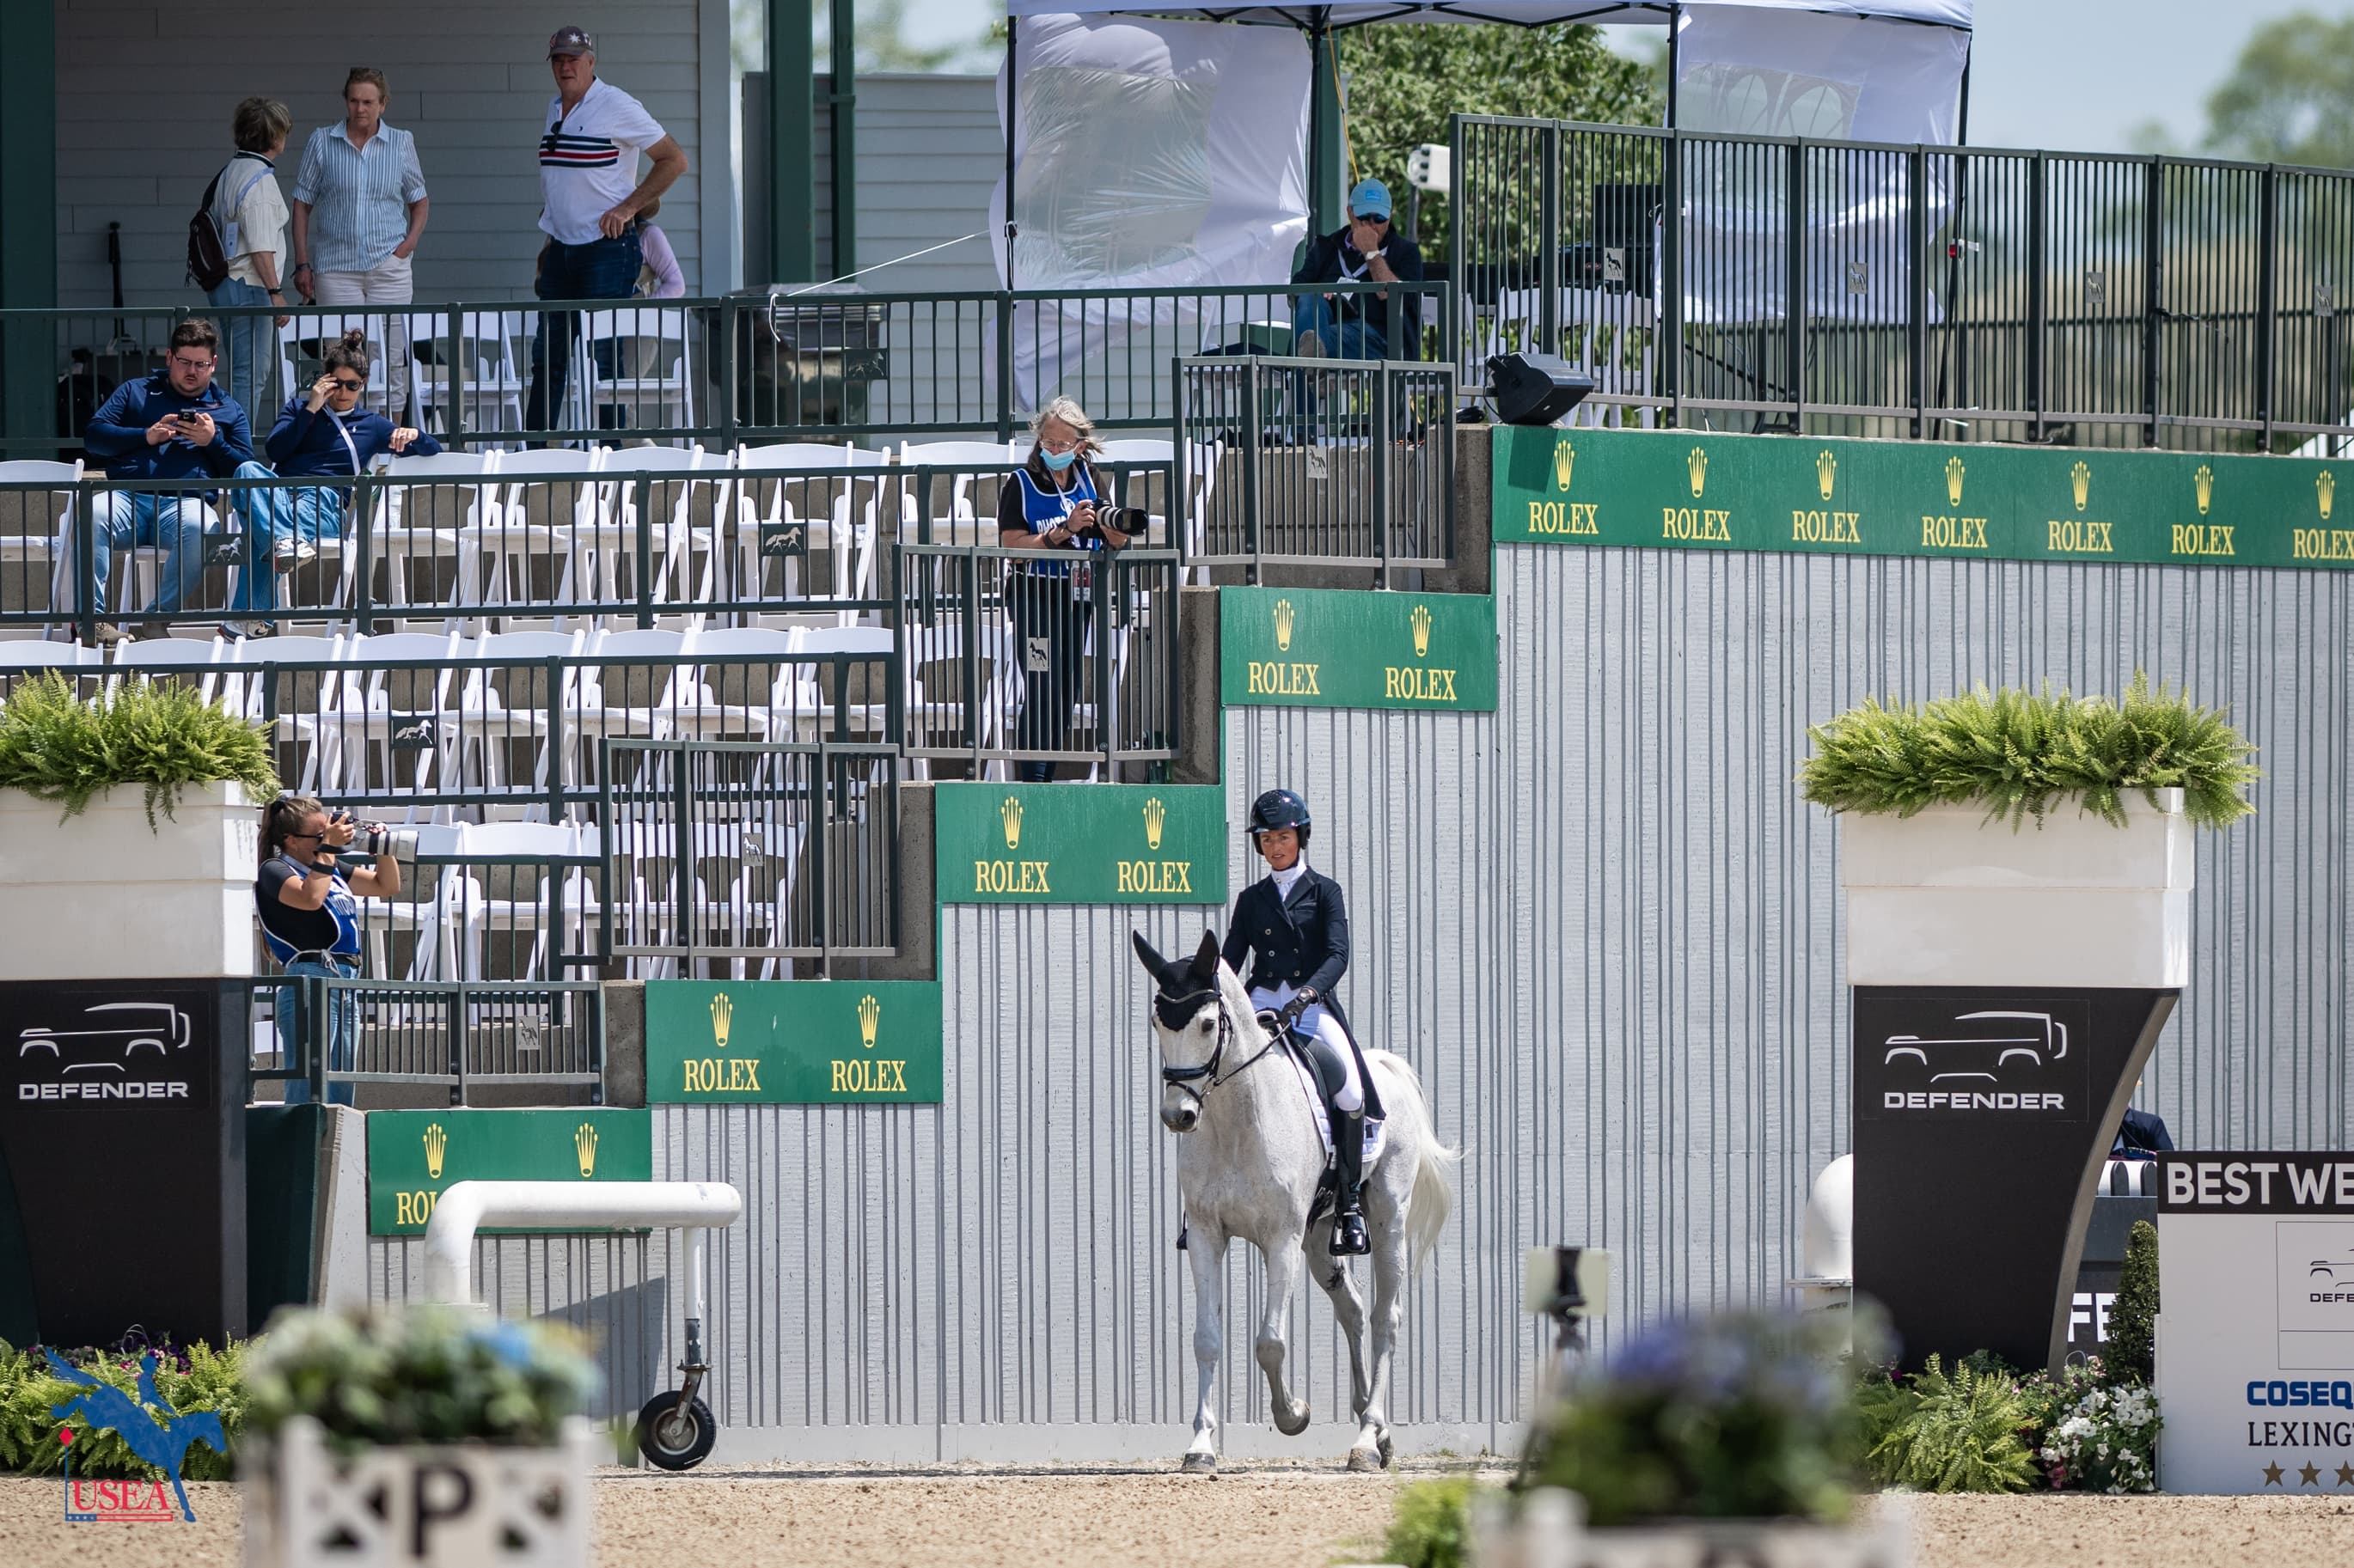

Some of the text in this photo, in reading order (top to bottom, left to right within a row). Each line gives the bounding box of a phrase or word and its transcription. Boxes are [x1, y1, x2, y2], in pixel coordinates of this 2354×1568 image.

[1528, 501, 1599, 534] ROLEX
[1663, 508, 1731, 541] ROLEX
[1792, 510, 1861, 543] ROLEX
[1922, 516, 1988, 548] ROLEX
[2048, 521, 2113, 552] ROLEX
[2172, 524, 2235, 556] ROLEX
[2293, 528, 2354, 560] ROLEX
[1248, 662, 1320, 695] ROLEX
[1385, 667, 1458, 701] ROLEX
[975, 860, 1051, 894] ROLEX
[1117, 860, 1192, 894] ROLEX
[19, 1081, 188, 1101] DEFENDER
[683, 1058, 761, 1092] ROLEX
[831, 1059, 908, 1093] ROLEX
[1884, 1092, 2064, 1110] DEFENDER
[2167, 1162, 2354, 1205] BEST WE
[2309, 1293, 2354, 1303] DEFE
[2247, 1381, 2354, 1410] COSEQ
[2247, 1421, 2354, 1448] LEXING
[412, 1464, 478, 1559] P
